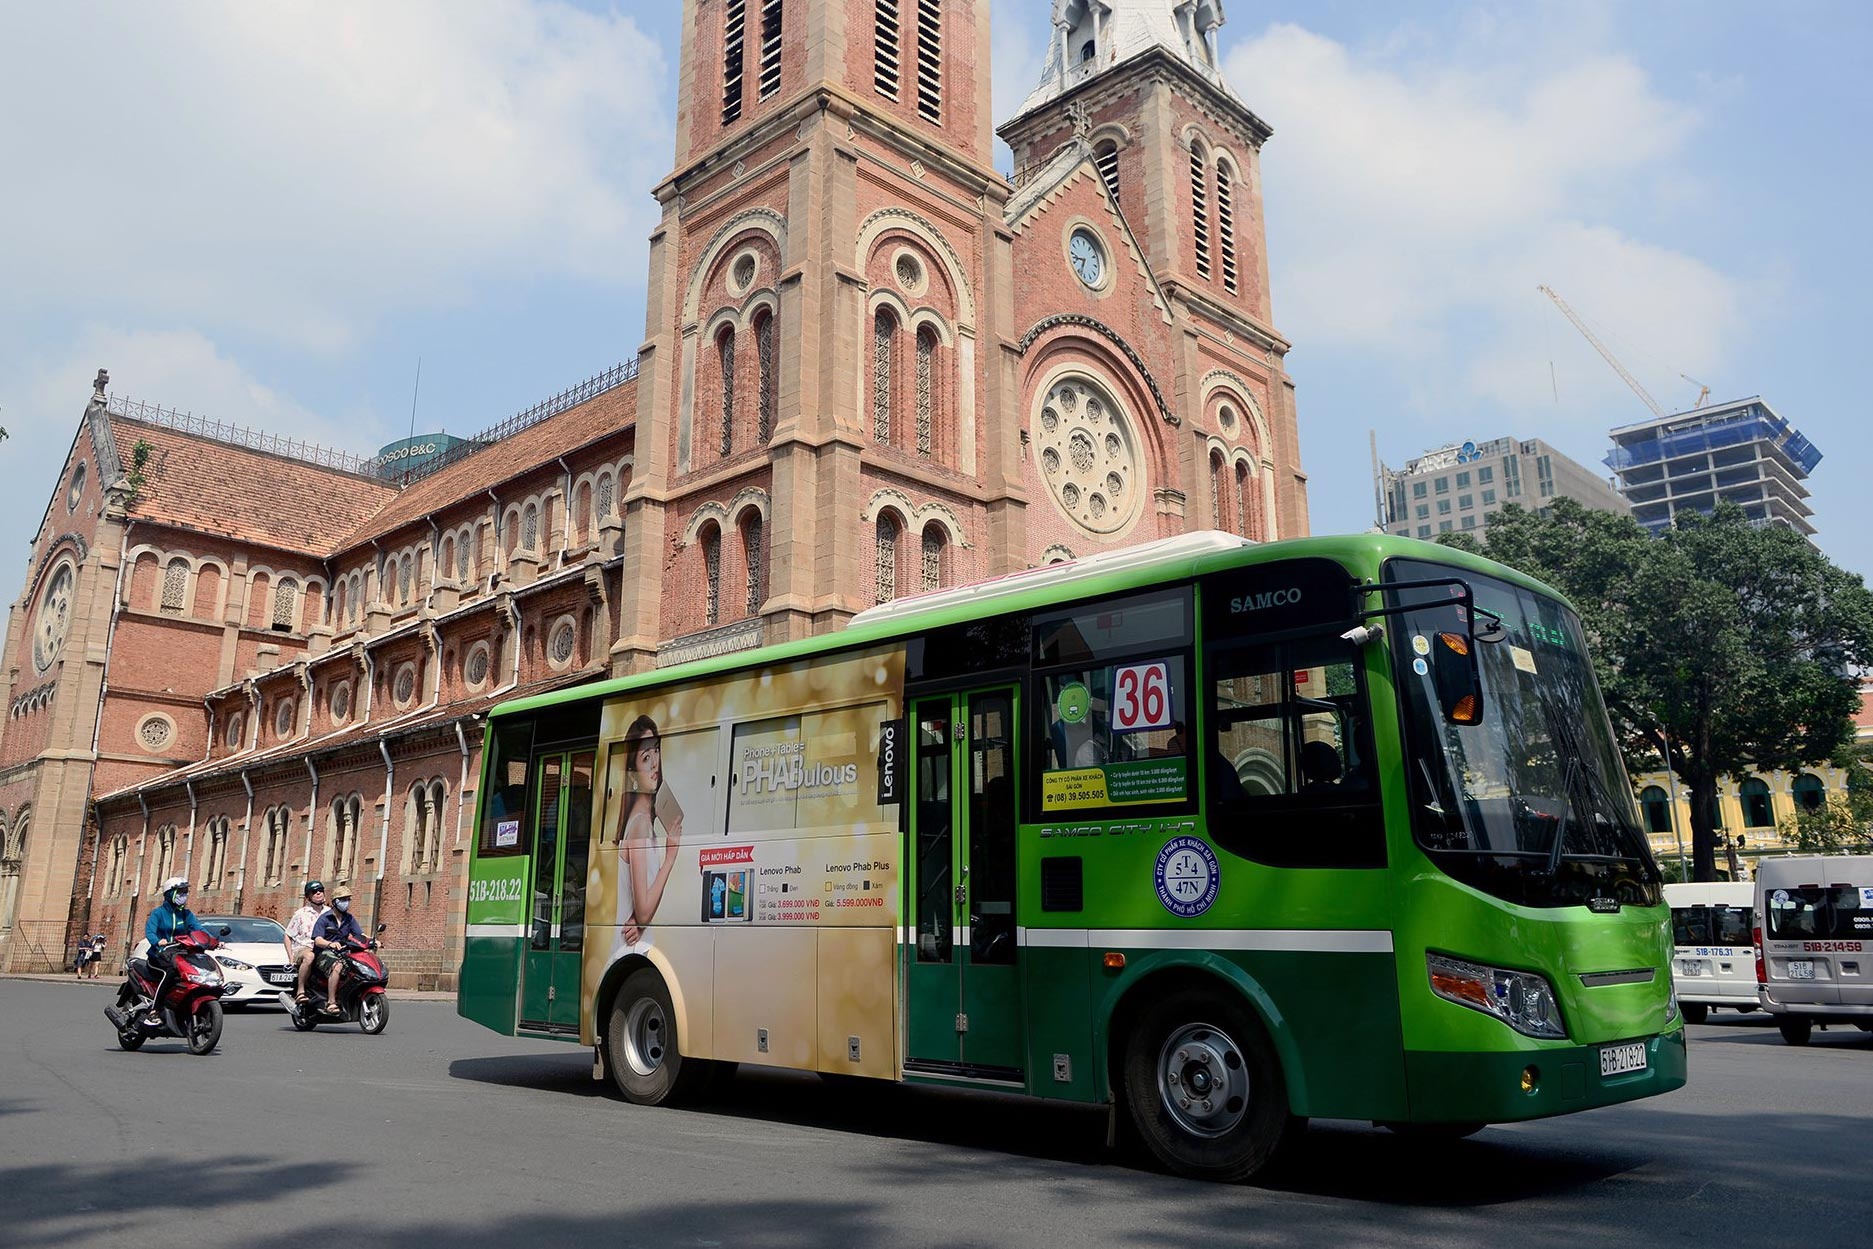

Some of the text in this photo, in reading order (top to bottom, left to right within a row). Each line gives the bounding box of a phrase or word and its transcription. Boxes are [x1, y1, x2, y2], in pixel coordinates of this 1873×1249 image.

[1230, 588, 1301, 613] SAMCO
[1119, 666, 1164, 726] 36
[883, 727, 895, 798] Lenovo
[741, 754, 858, 795] PHABulous
[1054, 790, 1105, 804] (08) 39.505.505
[1040, 826, 1103, 838] SAMCO
[1109, 823, 1152, 835] CITY
[760, 865, 802, 876] Lenovo Phab
[825, 861, 890, 872] Lenovo Phab Plus
[469, 878, 521, 902] 51B-218.22
[1176, 881, 1199, 894] 47N
[806, 899, 820, 908] VNĐ
[806, 911, 820, 920] VNĐ
[1696, 948, 1733, 956] 51B-176.31
[1602, 1045, 1645, 1073] 51B-218.22
